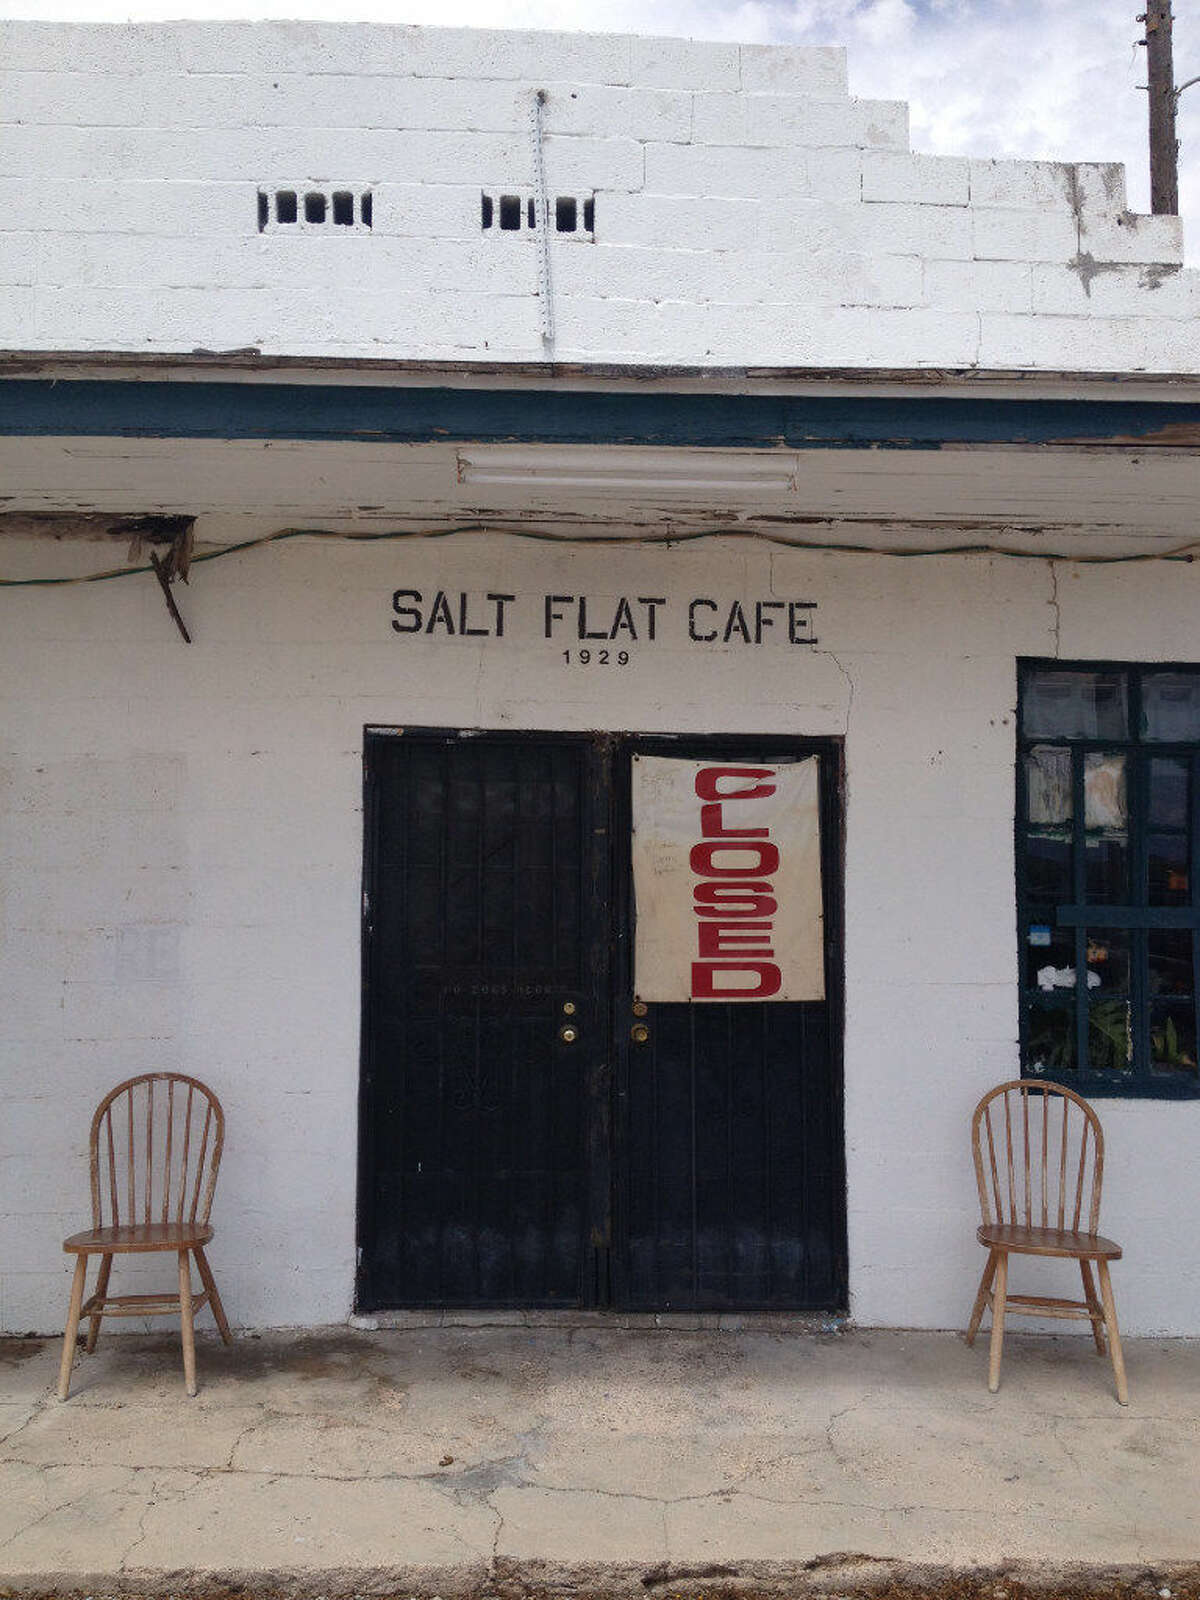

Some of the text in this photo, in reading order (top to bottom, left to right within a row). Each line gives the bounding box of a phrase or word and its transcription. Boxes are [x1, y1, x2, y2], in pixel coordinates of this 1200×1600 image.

[391, 590, 819, 644] SALT FLAT CAFE
[562, 649, 630, 666] 1929
[689, 767, 782, 999] CLOSED
